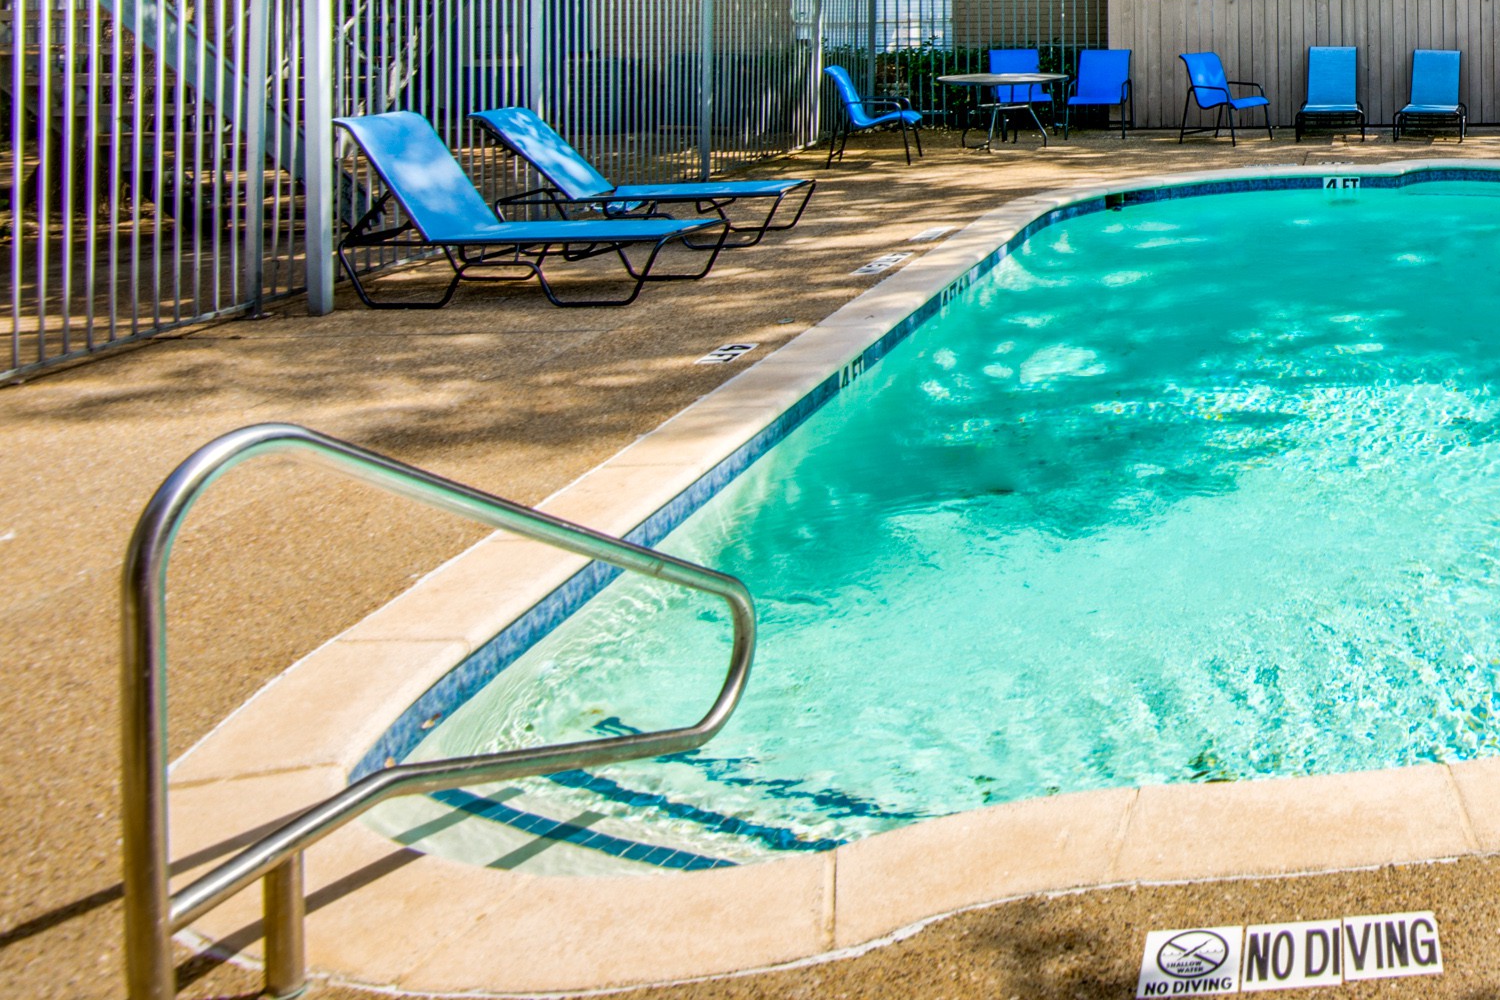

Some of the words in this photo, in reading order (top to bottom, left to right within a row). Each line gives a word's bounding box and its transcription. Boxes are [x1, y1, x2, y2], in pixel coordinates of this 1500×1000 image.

[1326, 178, 1337, 189] 4
[1342, 178, 1359, 189] FT
[841, 365, 850, 389] 4
[852, 354, 863, 381] FT
[1245, 930, 1295, 982] NO
[1304, 917, 1438, 978] DIVING
[1166, 960, 1202, 968] SHALLOW
[1177, 966, 1204, 974] WATER
[1144, 981, 1169, 996] NO
[1172, 976, 1233, 994] DIVING
